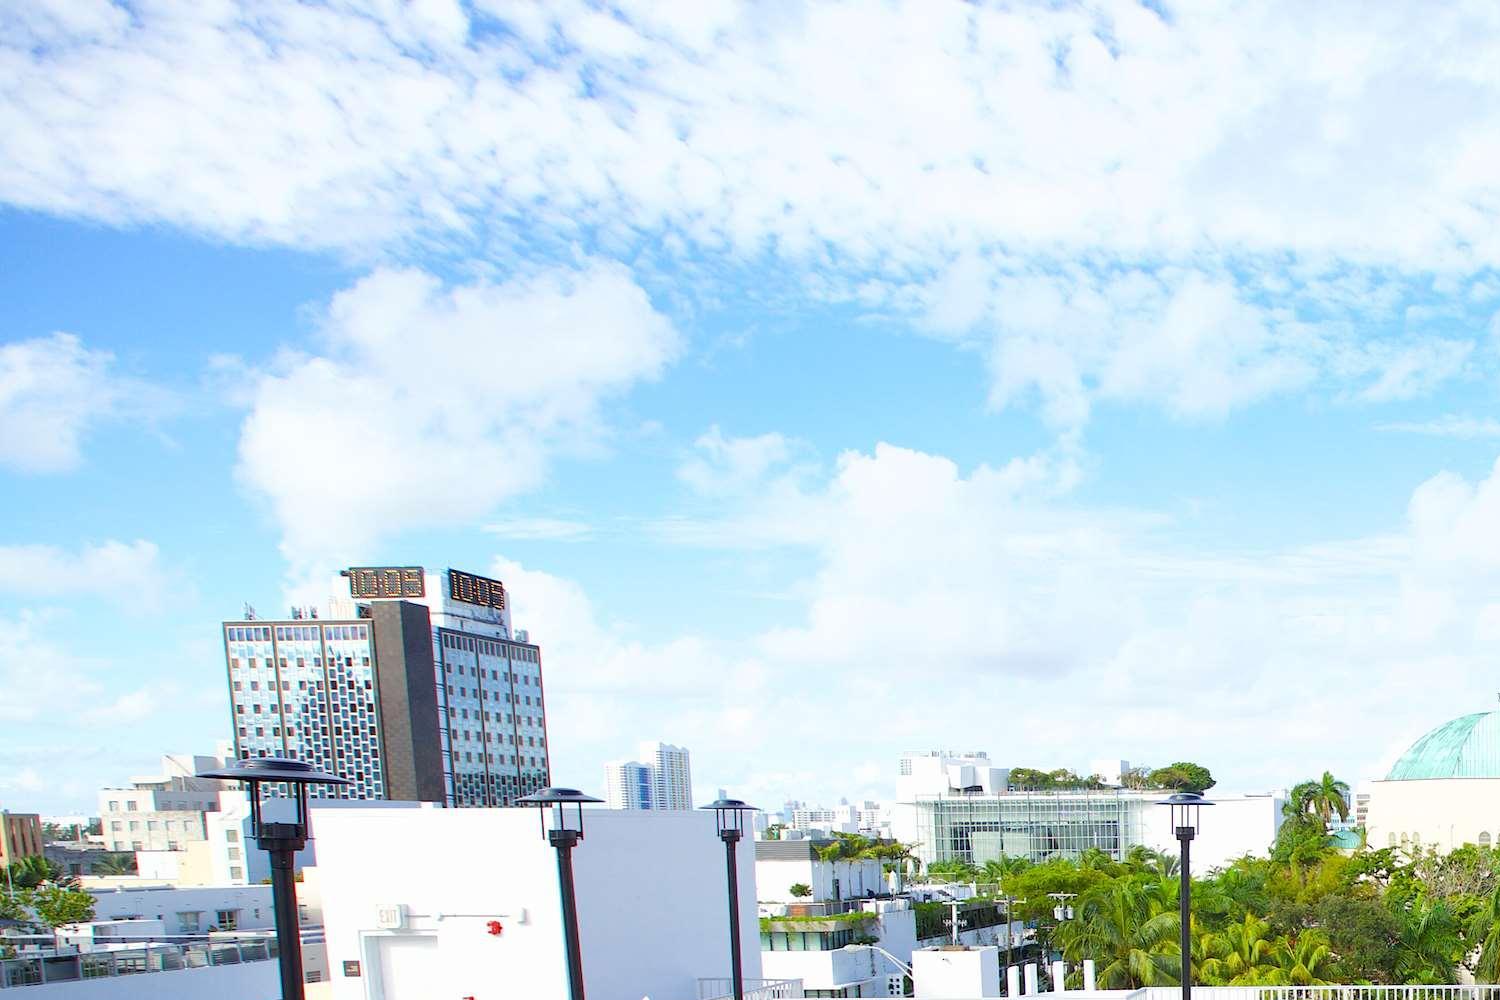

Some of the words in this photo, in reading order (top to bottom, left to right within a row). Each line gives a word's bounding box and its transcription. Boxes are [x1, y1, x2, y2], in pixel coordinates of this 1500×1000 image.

[351, 568, 423, 598] 10:05
[451, 571, 505, 610] 10:05
[379, 909, 398, 924] EXIT
